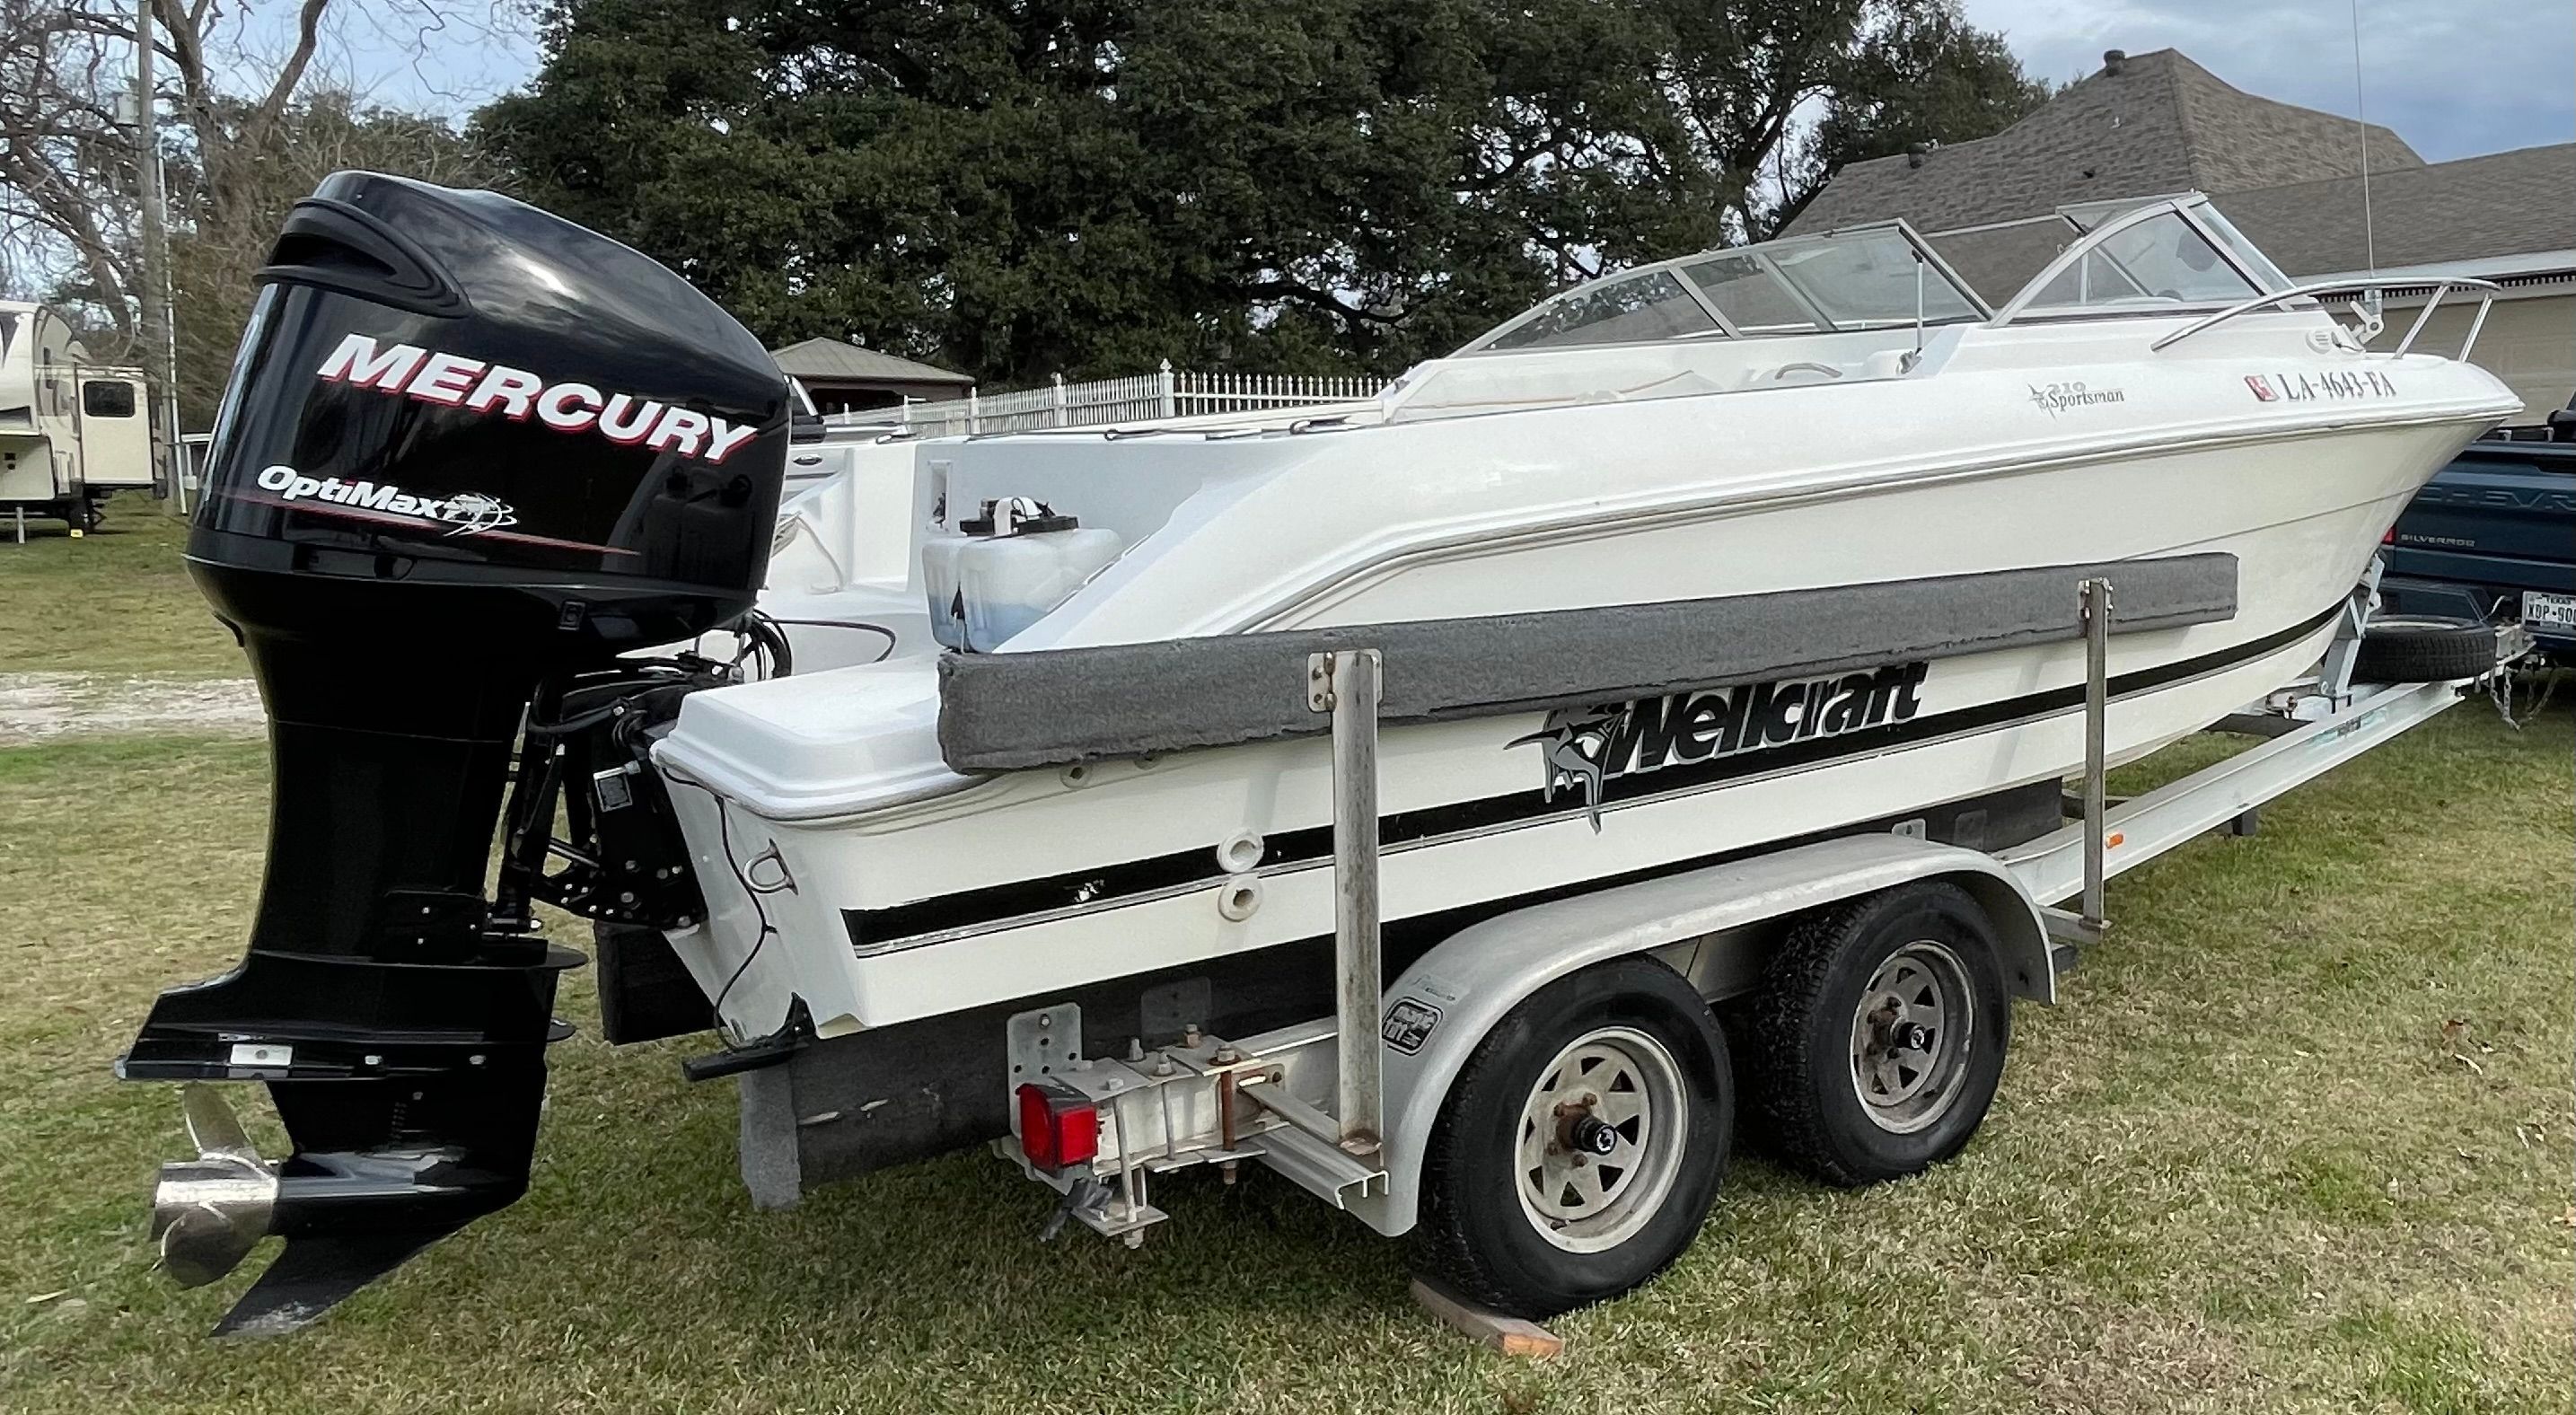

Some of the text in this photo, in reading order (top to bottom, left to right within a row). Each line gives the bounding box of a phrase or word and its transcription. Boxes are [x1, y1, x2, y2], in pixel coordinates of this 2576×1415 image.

[316, 332, 759, 465] MERCURY
[2047, 390, 2125, 412] Sportsman
[257, 465, 452, 520] OptiMax
[2401, 533, 2476, 548] SILVERADO
[1601, 659, 1930, 780] Wellcraft
